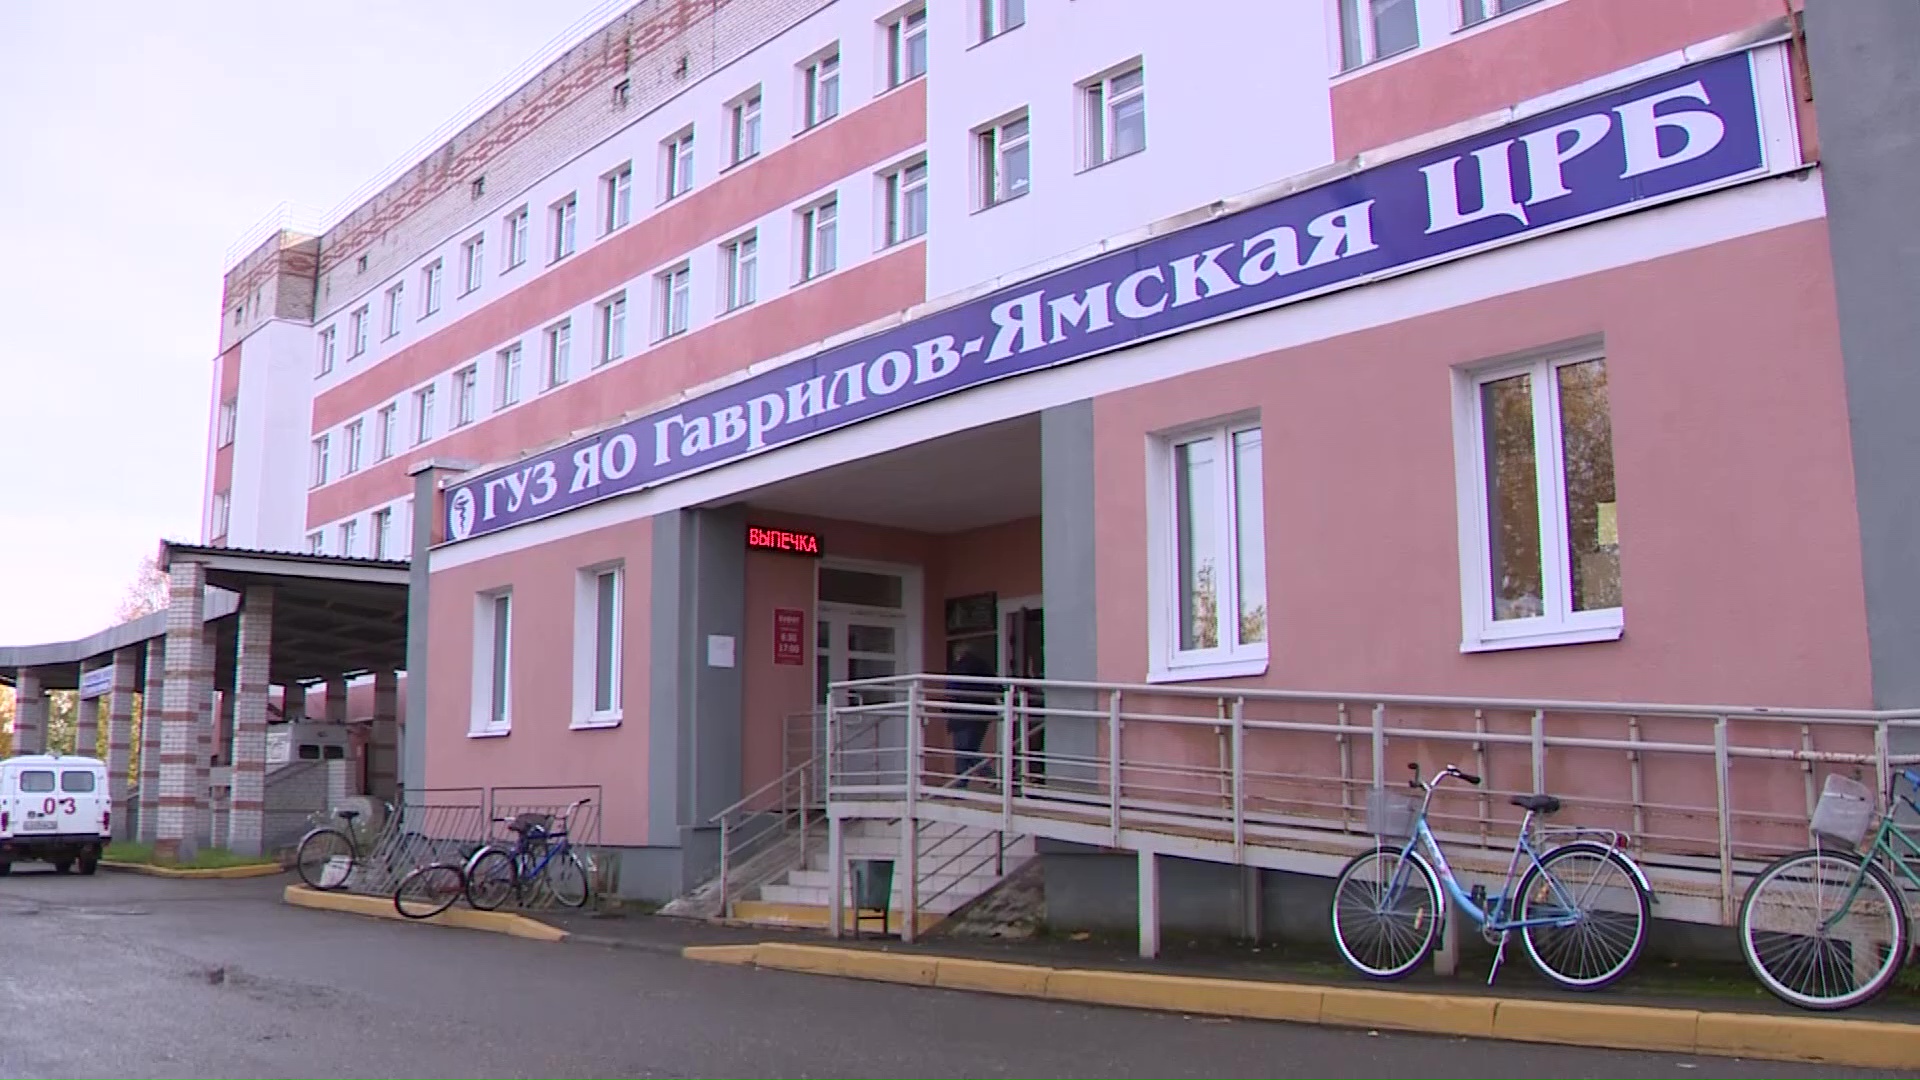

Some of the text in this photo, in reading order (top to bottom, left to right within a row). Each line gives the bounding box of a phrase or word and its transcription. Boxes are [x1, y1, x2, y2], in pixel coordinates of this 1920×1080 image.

[483, 80, 1727, 520] ГУЗ ЯО Гаврилов-Ямская ЦРБ
[749, 528, 818, 553] ВЫПЕЧКА
[43, 797, 76, 815] 03
